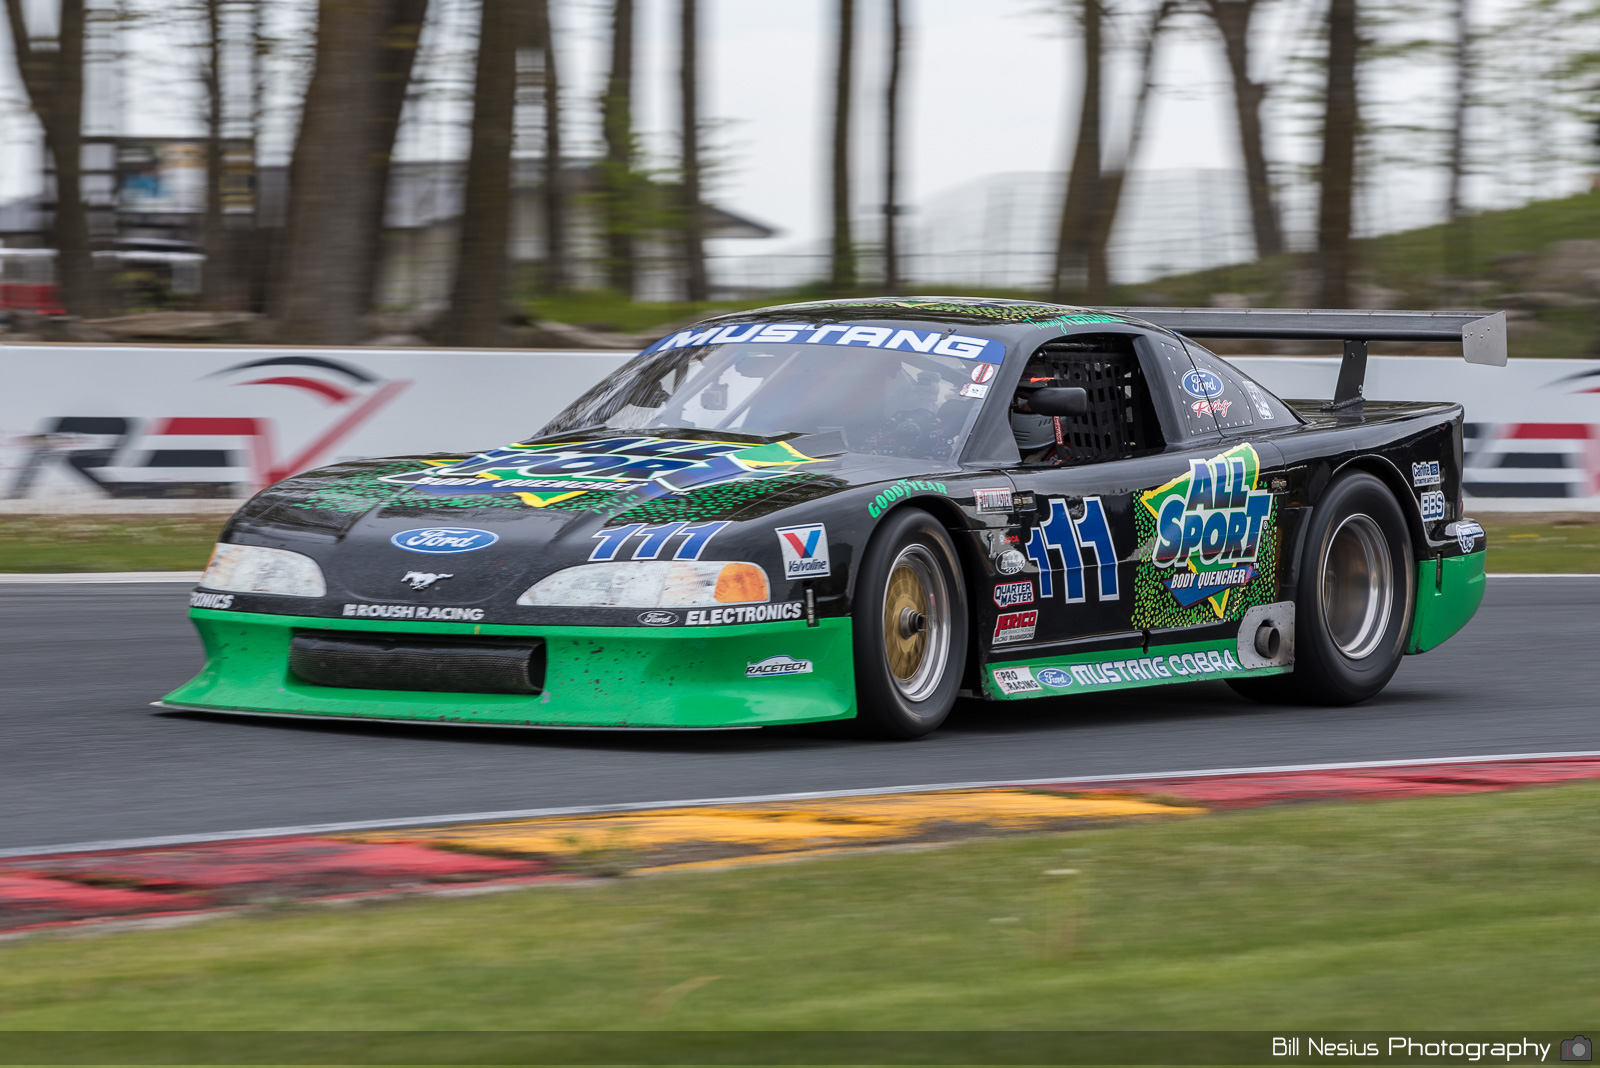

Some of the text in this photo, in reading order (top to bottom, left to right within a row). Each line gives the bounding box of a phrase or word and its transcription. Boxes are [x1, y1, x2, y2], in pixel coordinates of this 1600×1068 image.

[663, 323, 989, 358] MUSTANG
[1190, 372, 1218, 393] Ford
[1191, 400, 1232, 418] Racing
[416, 476, 497, 487] BODY
[1186, 457, 1249, 511] ALL
[867, 479, 948, 518] GOODYEAR
[1421, 492, 1444, 519] BBS
[400, 528, 480, 549] Ford
[1152, 490, 1273, 568] SPORT
[588, 521, 732, 561] 111
[1025, 497, 1120, 604] 111
[788, 558, 828, 573] Valvoline
[1169, 571, 1196, 590] BODY
[1197, 567, 1247, 588] QUENCHER
[995, 582, 1032, 600] QUARTER
[1001, 592, 1033, 606] MASTER
[356, 604, 485, 621] ROUSH RACING
[644, 603, 802, 626] Ford ELECTRONICS
[994, 611, 1037, 637] JERICO
[745, 662, 808, 674] RACETECH
[1000, 670, 1018, 681] PRO
[1044, 671, 1067, 684] Ford
[1069, 648, 1242, 686] MUSTANG COBRA
[1006, 679, 1039, 691] RACING
